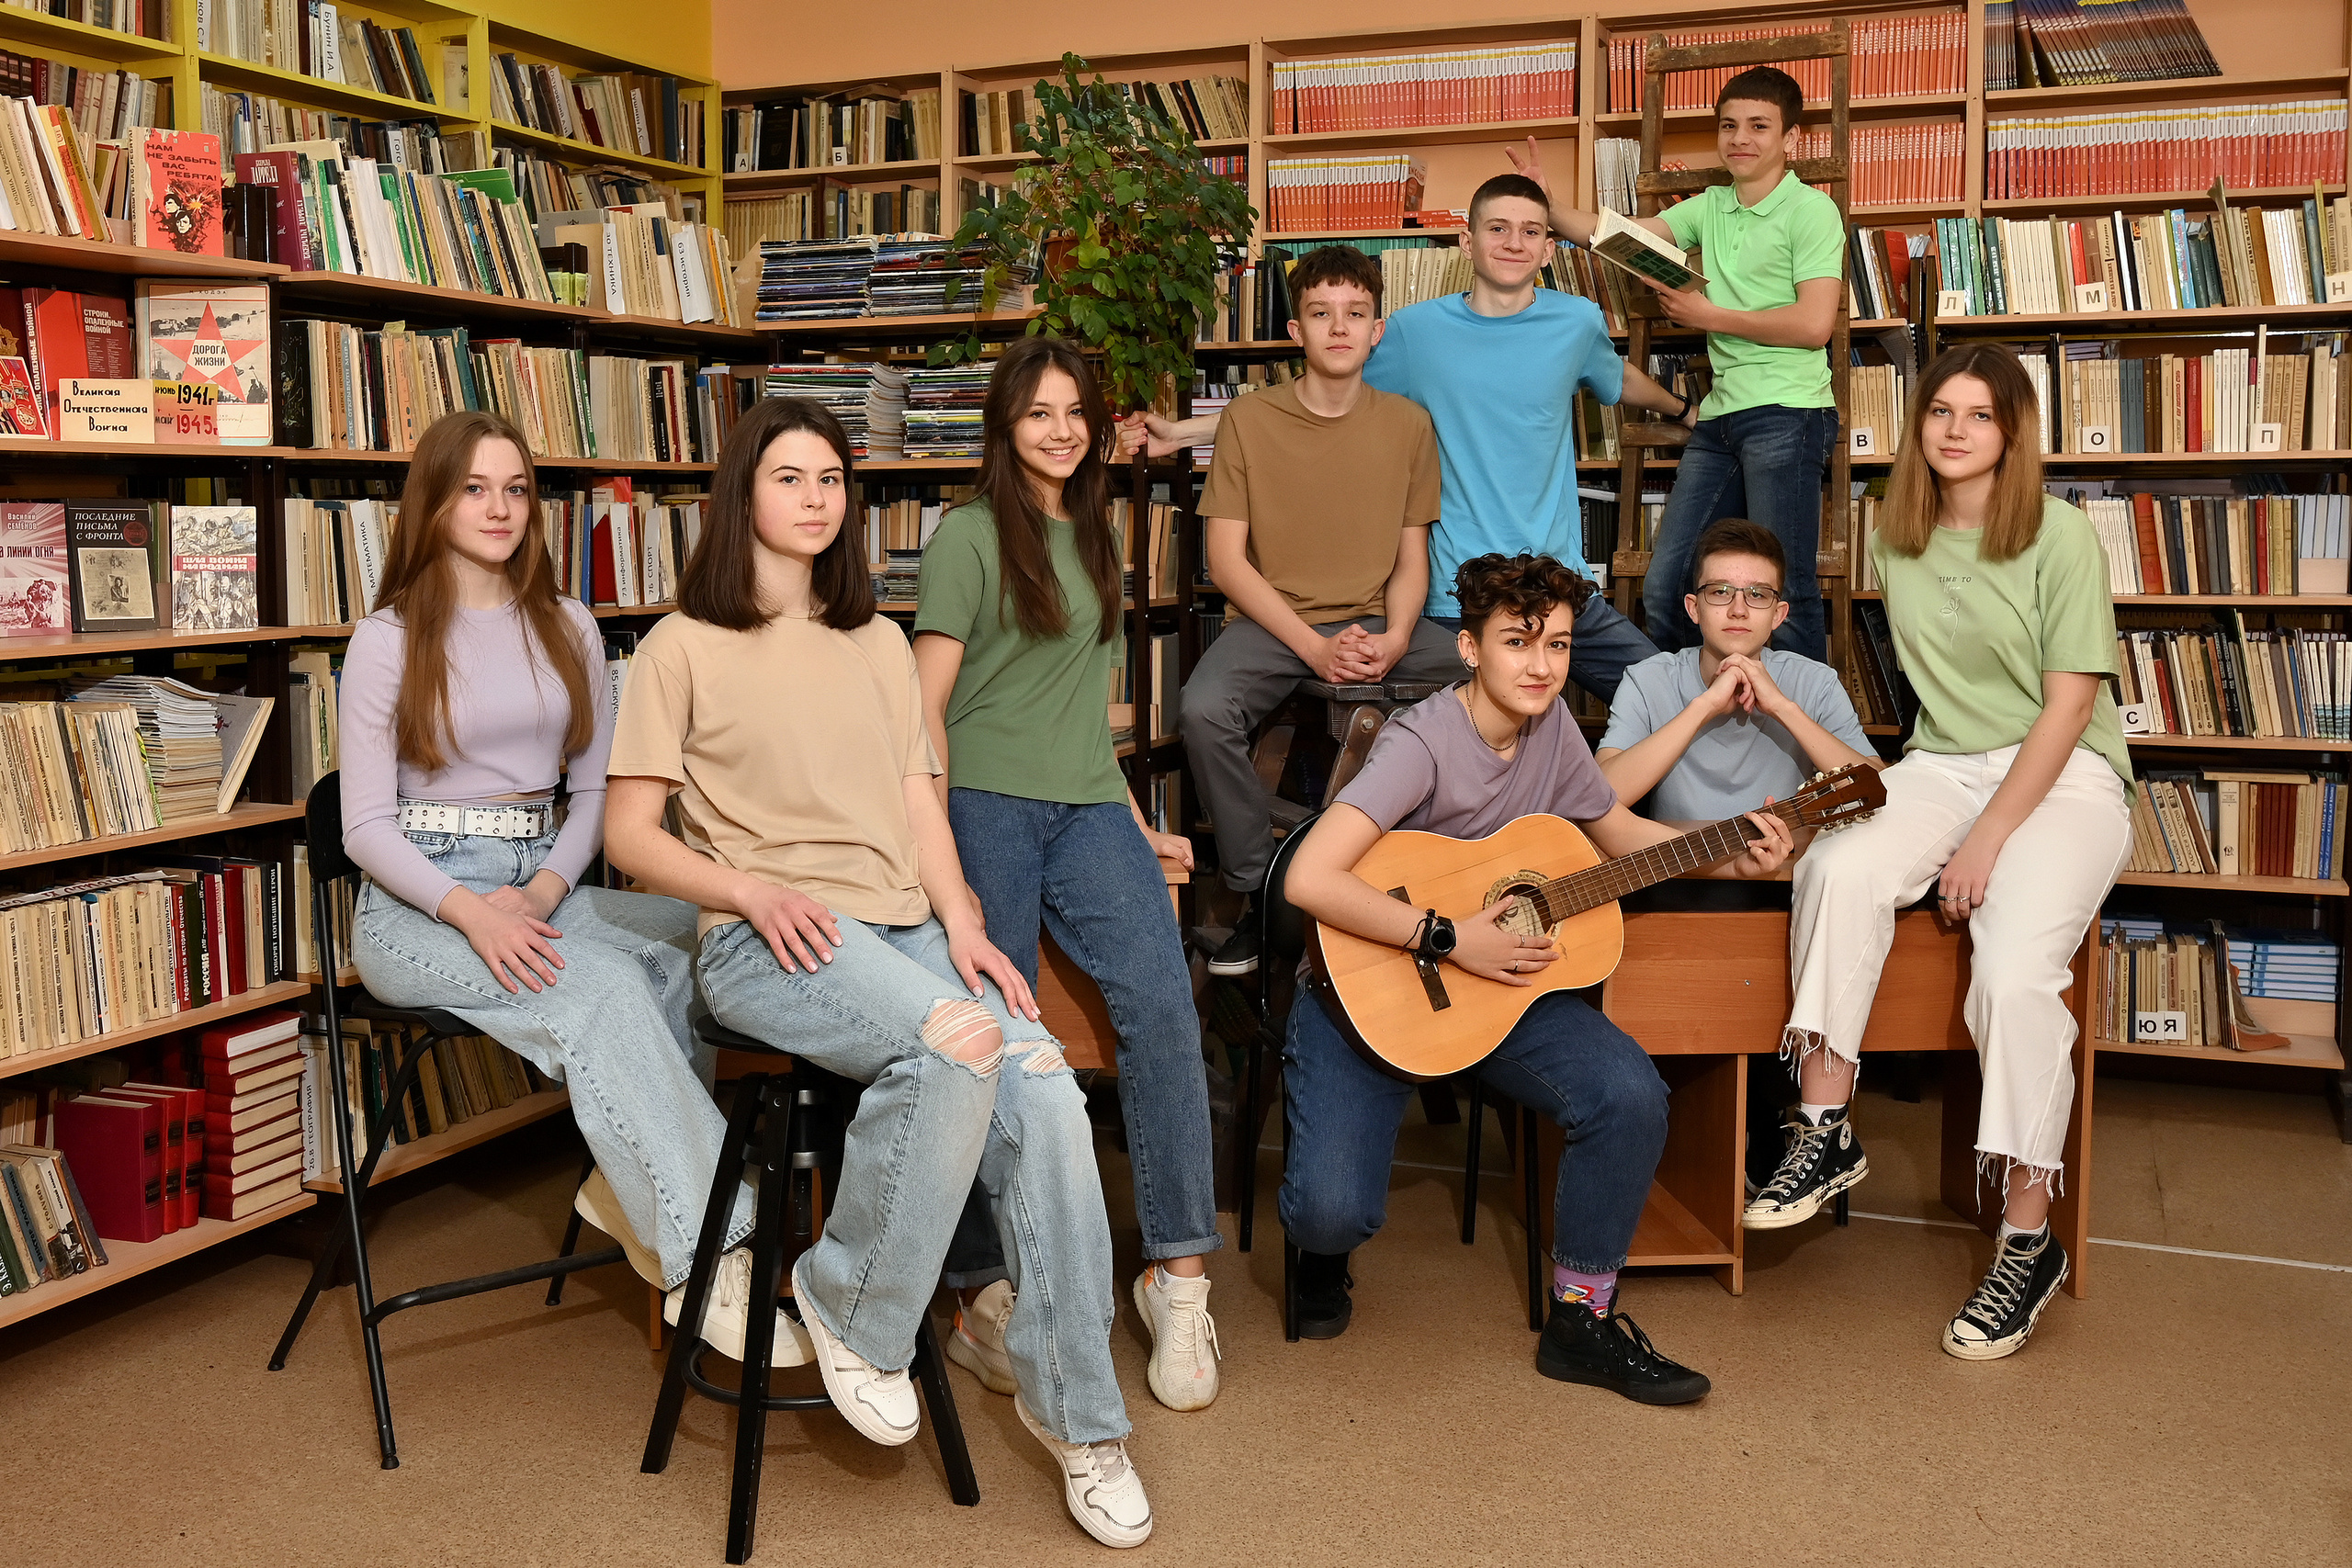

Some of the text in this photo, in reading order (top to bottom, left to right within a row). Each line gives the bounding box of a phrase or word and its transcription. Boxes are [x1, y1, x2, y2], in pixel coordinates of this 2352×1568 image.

[147, 143, 173, 152] НАМ
[393, 139, 401, 164] Гого
[168, 154, 217, 165] ЗАБЫТЬ
[740, 158, 747, 168] А
[835, 152, 842, 163] Б
[167, 171, 217, 181] РЕБЯТА!
[677, 242, 684, 254] 63
[607, 247, 617, 295] ТЕХНИКА
[2333, 282, 2345, 296] Н
[1944, 297, 1957, 310] Л
[2086, 291, 2100, 304] М
[24, 302, 35, 336] ВОЙНОЙ
[85, 317, 124, 328] ОПАЛЕННЫЕ
[85, 324, 111, 334] ВОЙНОЙ
[192, 344, 226, 355] ДОРОГА
[194, 356, 226, 367] ЖИЗНИ
[1856, 434, 1868, 446] В
[2091, 432, 2104, 446] О
[2262, 430, 2273, 444] П
[7, 513, 36, 521] Василий
[74, 513, 136, 521] ПОСЛЕДНИЕ
[76, 522, 118, 531] ПИСЬМА
[85, 532, 125, 541] ФРОНТА
[6, 546, 54, 558] ЛИНИИ ОГНЯ
[360, 521, 376, 588] МАТЕМАТИКА
[617, 526, 628, 597] 73 информатика
[2126, 711, 2138, 725] С
[2161, 809, 2183, 867] АЛЕКСЕЙ ТОЛСТОЙ
[2174, 809, 2196, 867] АЛЕКСЕЙ ТОЛСТОЙ
[201, 952, 210, 996] РОССИЯ
[182, 966, 190, 1001] Рефераты
[2139, 1019, 2177, 1033] Ю Я
[305, 1084, 314, 1144] ГЕОГРАФИЯ
[7, 1170, 31, 1226] ТАЛАЛИХИН
[28, 1227, 44, 1262] ВИКТОР
